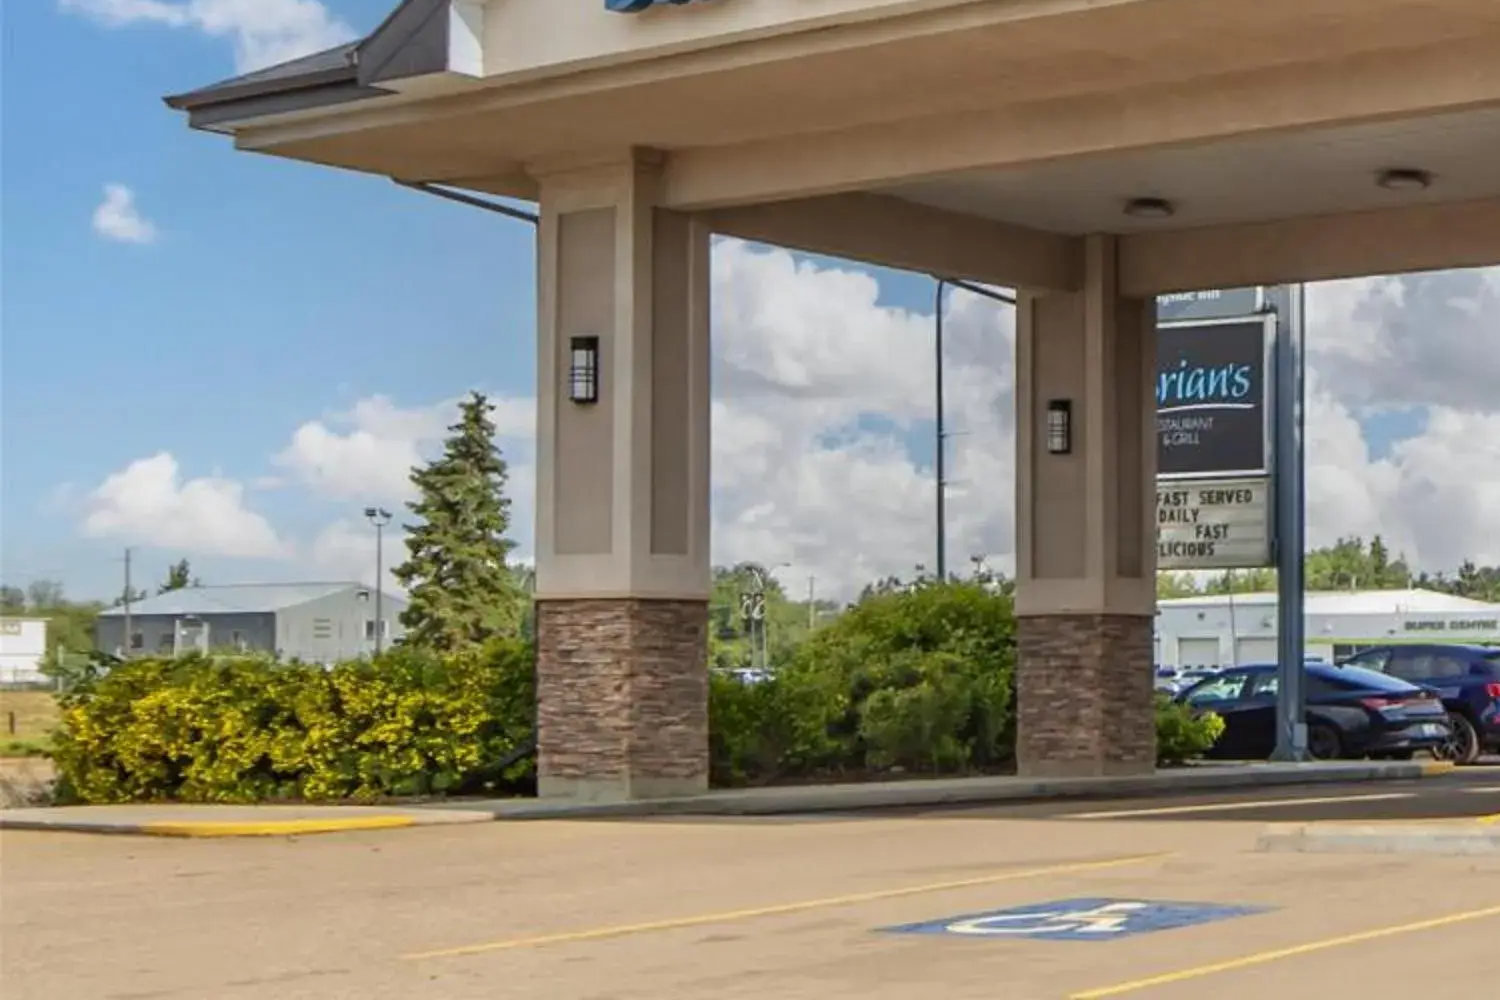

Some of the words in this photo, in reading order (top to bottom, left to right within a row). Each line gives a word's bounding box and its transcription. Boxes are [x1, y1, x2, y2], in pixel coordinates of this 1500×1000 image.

[1156, 360, 1251, 404] rian's
[1157, 416, 1214, 431] STAURANT
[1199, 489, 1253, 505] SERVED
[1160, 508, 1199, 523] DAILY
[1195, 523, 1229, 539] FAST
[1158, 541, 1215, 557] LICIOUS
